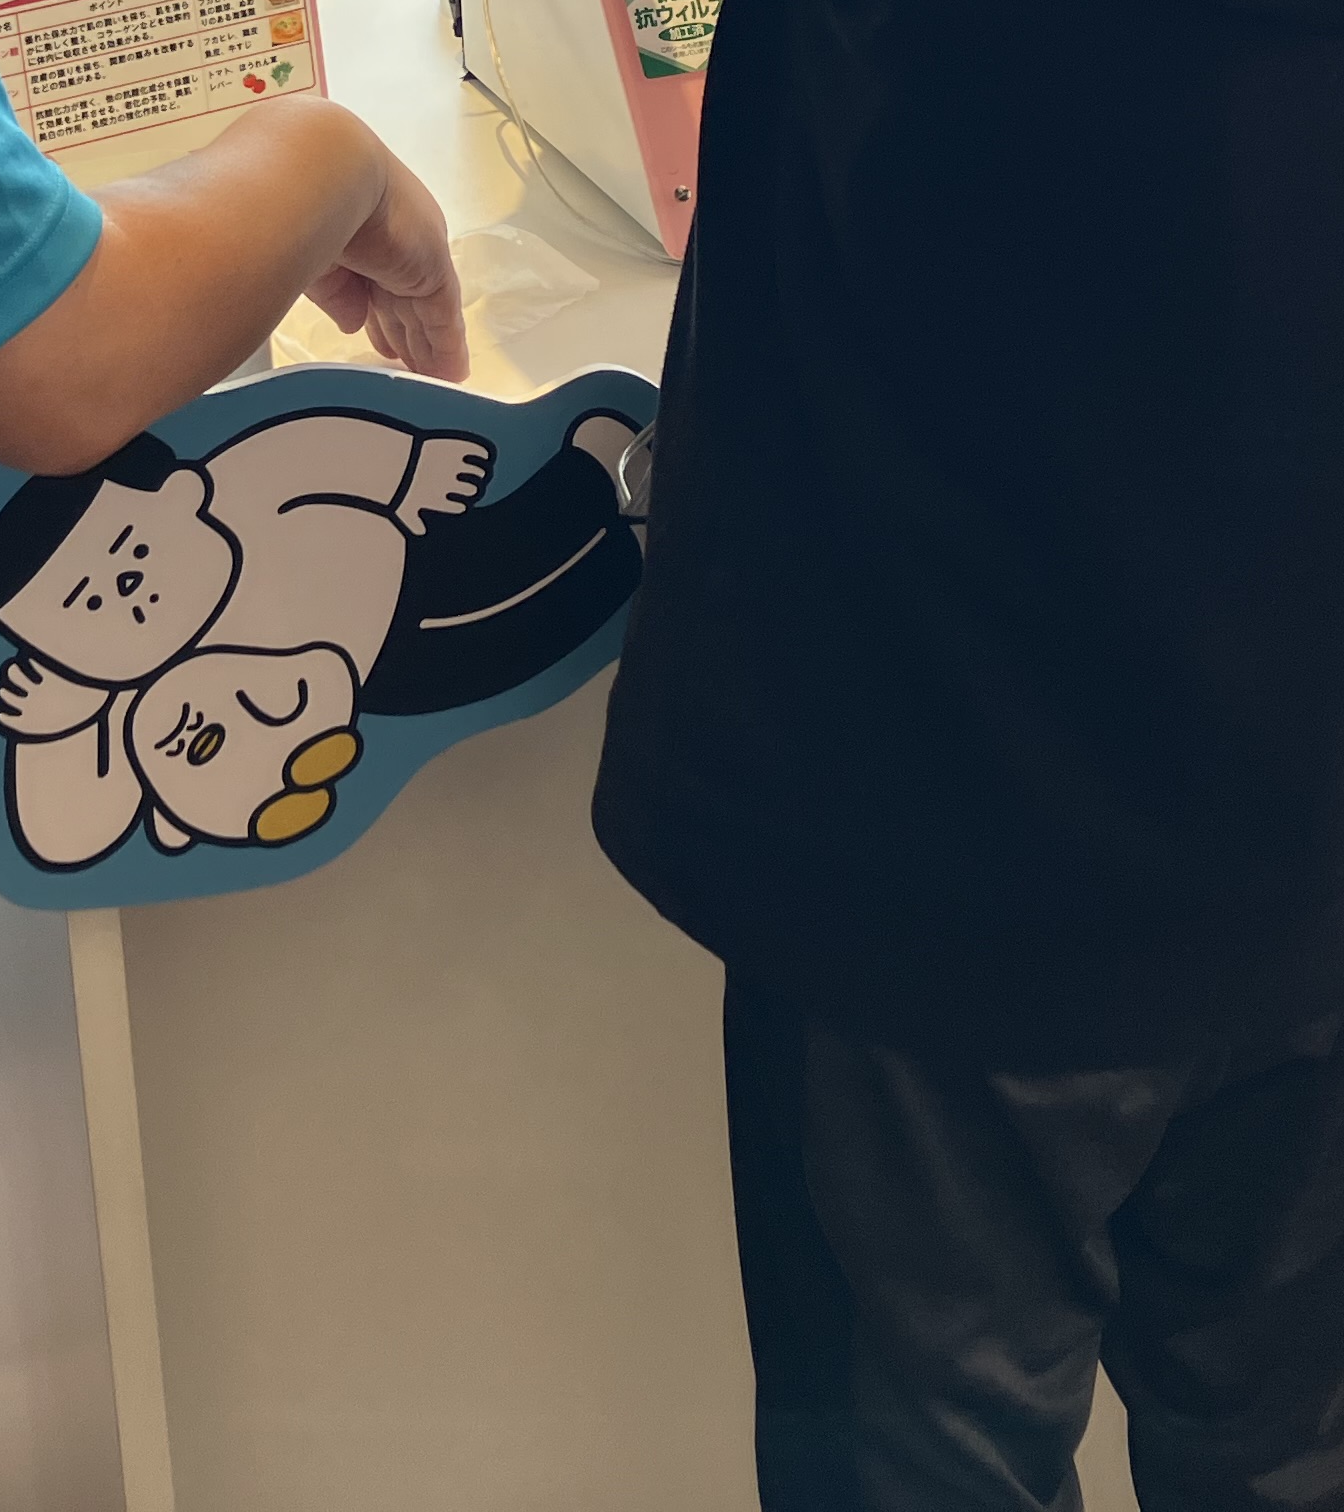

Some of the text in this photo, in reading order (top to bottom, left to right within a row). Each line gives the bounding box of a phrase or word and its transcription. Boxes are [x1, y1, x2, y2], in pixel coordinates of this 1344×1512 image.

[669, 23, 705, 41] 加工済
[209, 79, 233, 92] レバー
